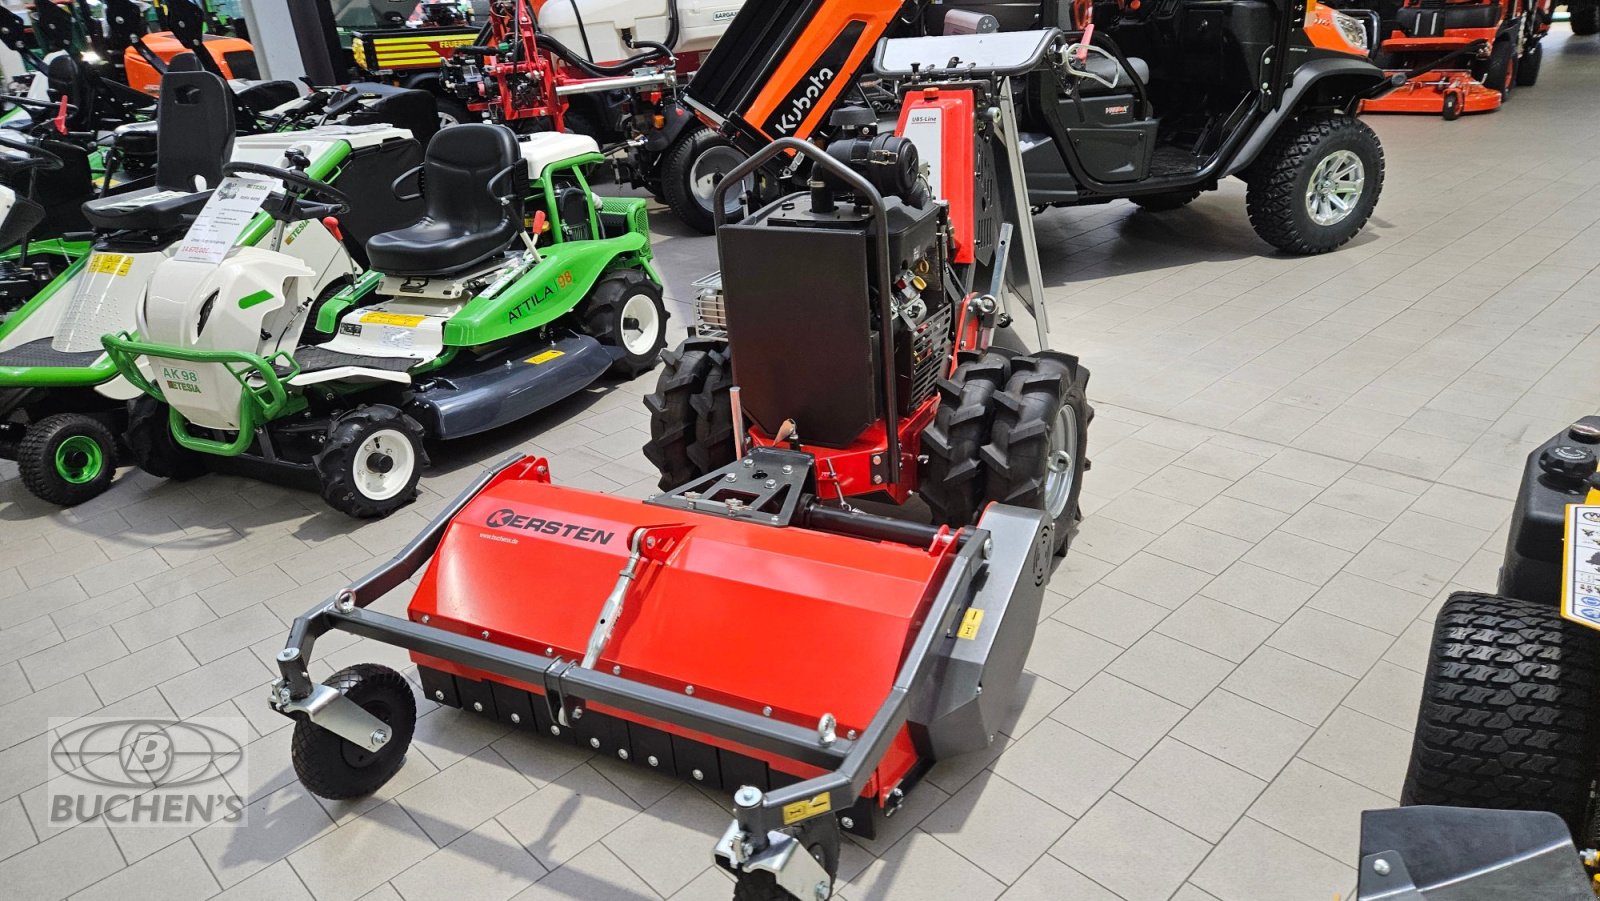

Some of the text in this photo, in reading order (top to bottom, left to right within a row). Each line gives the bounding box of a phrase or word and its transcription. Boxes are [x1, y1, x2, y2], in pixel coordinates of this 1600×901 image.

[775, 68, 834, 134] Kubota
[508, 285, 554, 325] ATTILA
[557, 270, 573, 289] 98
[163, 367, 198, 382] AK 98
[167, 380, 202, 393] ETESIA
[486, 508, 615, 545] KERSTEN
